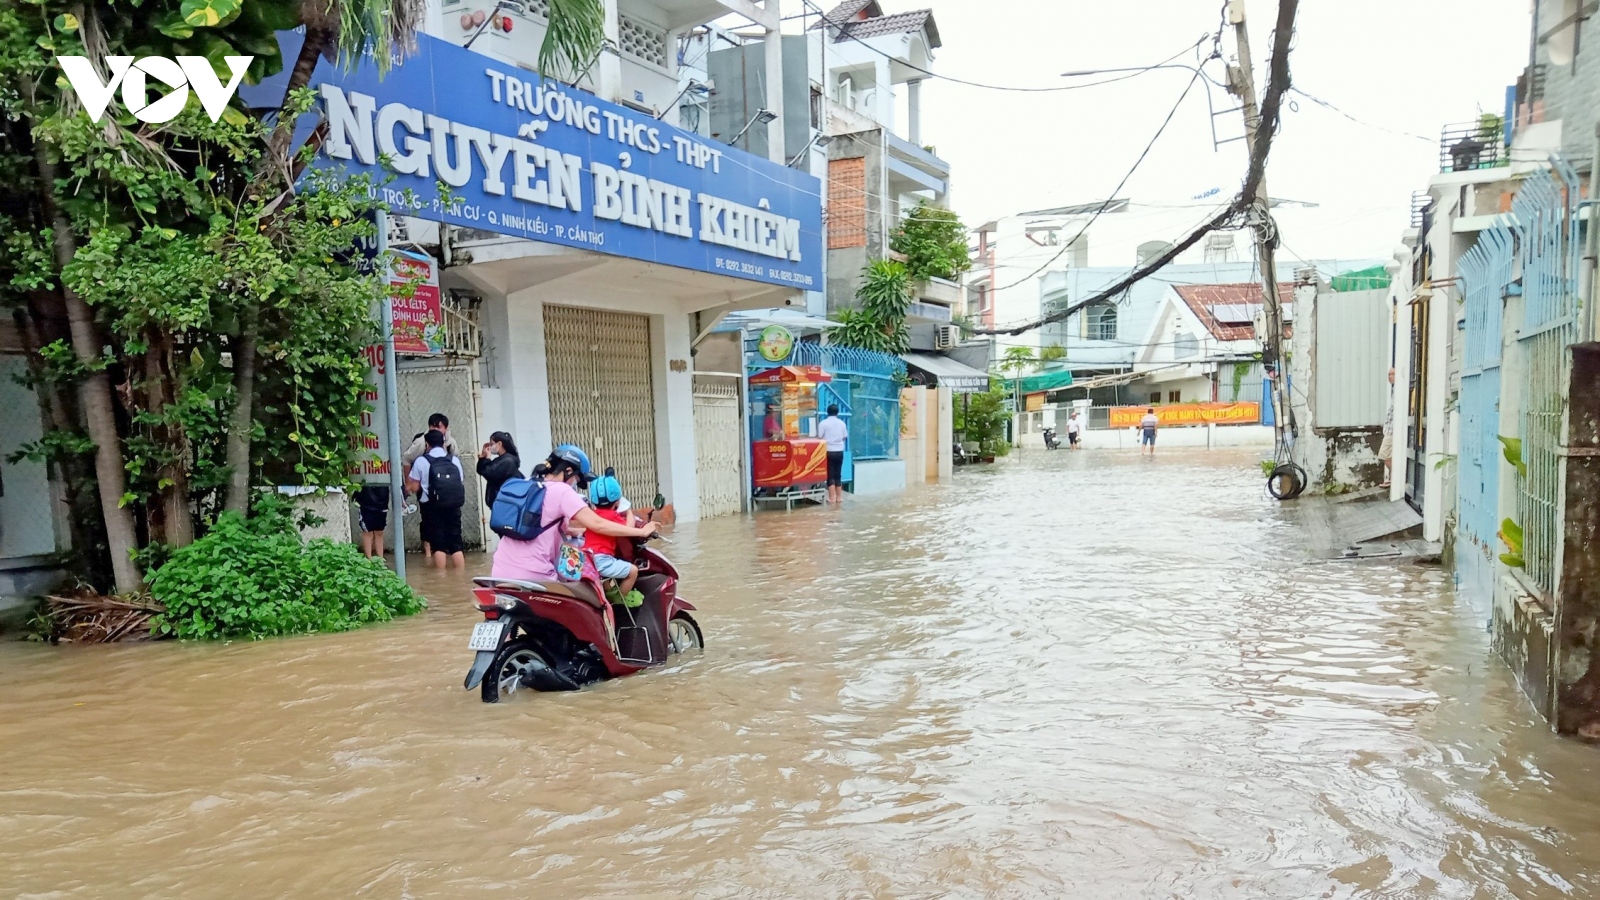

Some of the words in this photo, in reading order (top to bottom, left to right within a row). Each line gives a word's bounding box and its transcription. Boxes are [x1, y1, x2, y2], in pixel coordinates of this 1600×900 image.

[318, 82, 583, 213] NGUYỄN
[590, 152, 692, 239] BỈNH
[697, 193, 802, 262] KHIÊM
[485, 68, 601, 136] TRƯỜNG
[602, 110, 661, 155] THCS
[672, 135, 723, 174] THPT
[433, 198, 462, 218] PAN
[463, 204, 480, 221] CƯ
[488, 210, 500, 226] Q.
[501, 212, 526, 231] NINH
[588, 230, 605, 246] THƠ
